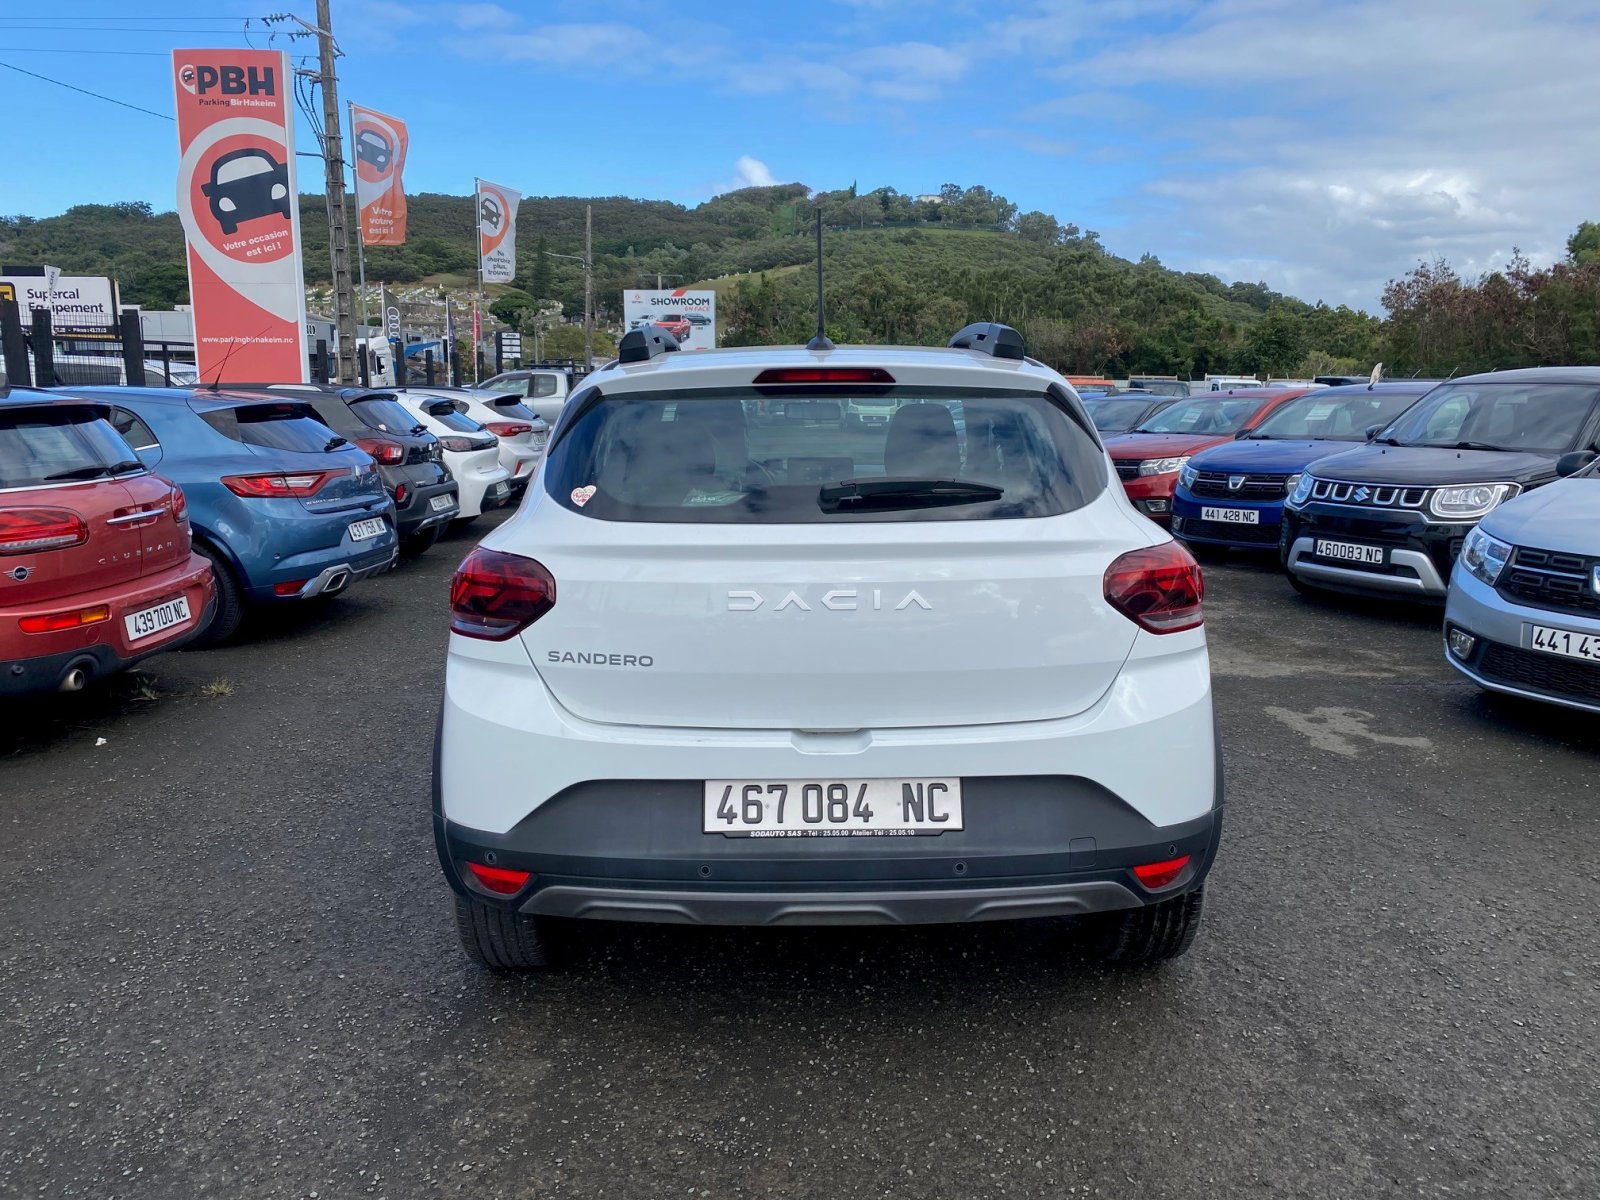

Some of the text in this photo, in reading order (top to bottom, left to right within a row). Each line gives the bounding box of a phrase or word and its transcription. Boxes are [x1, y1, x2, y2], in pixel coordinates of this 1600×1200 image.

[196, 65, 275, 96] PBH
[223, 229, 289, 251] Votre occasion
[246, 246, 262, 257] est
[263, 242, 276, 253] ici
[27, 288, 80, 301] Supercal
[650, 297, 710, 306] SHOWROOM
[1204, 511, 1255, 523] 441 428 NC
[98, 542, 172, 564] CLUBMAN
[1318, 542, 1382, 563] 460083 NC
[728, 590, 933, 611] DACIA
[134, 600, 187, 635] 439 700 NC
[1535, 628, 1571, 654] 441
[547, 650, 654, 667] SANDERO
[716, 783, 949, 824] 467 084 NC
[750, 830, 785, 838] SODAUTO
